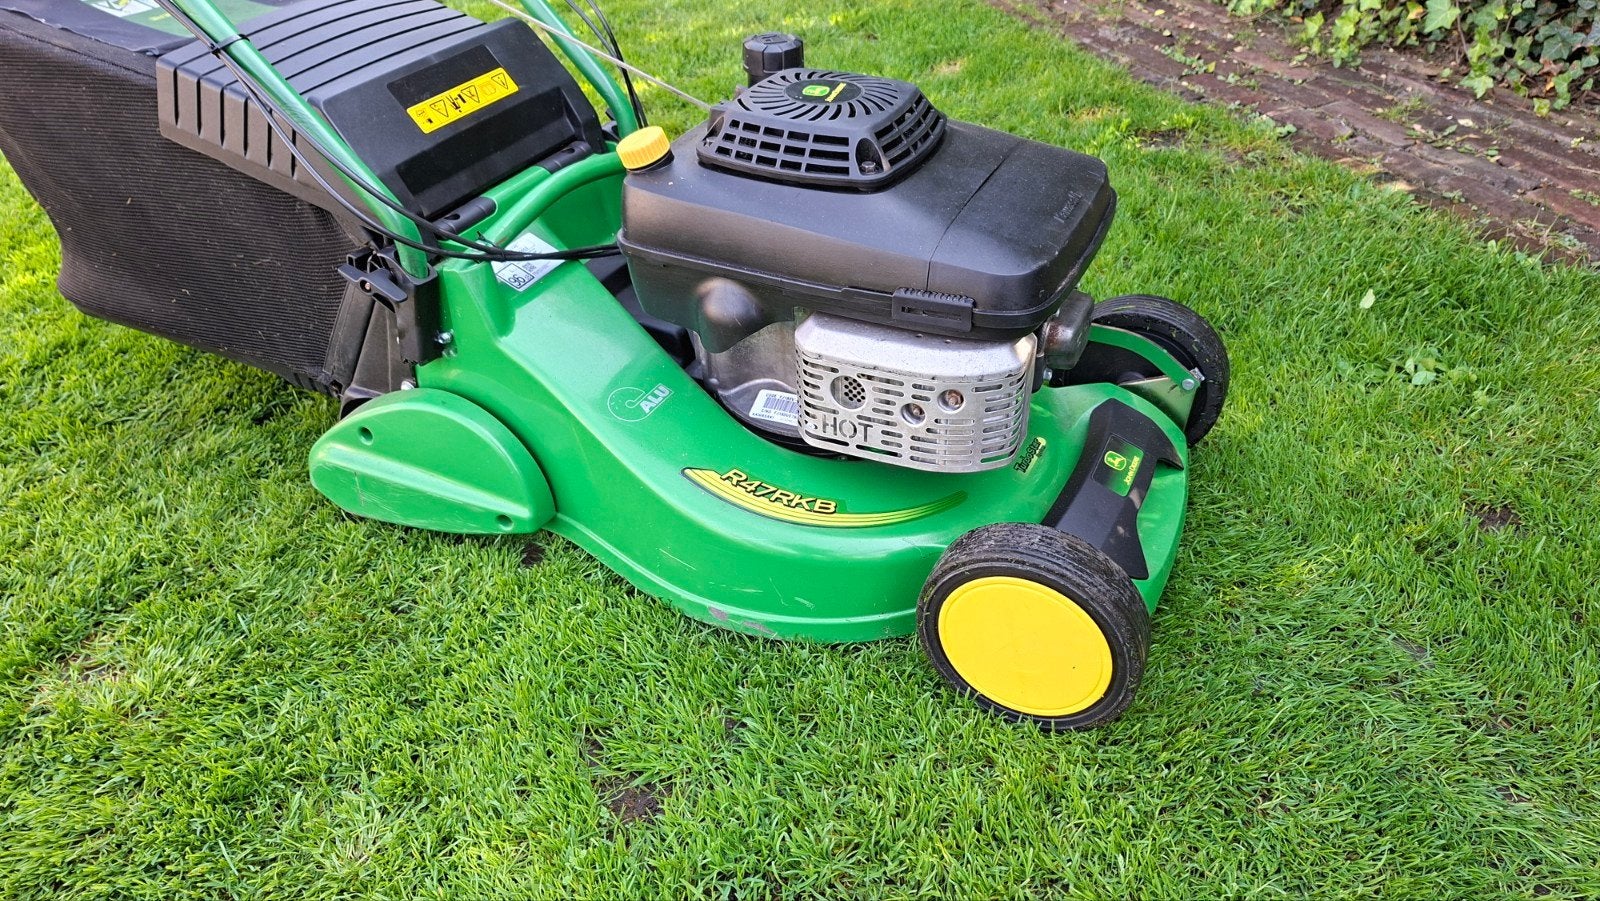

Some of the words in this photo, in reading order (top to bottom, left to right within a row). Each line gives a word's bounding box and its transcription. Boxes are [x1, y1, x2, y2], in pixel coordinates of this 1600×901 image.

[508, 273, 526, 286] 96
[639, 385, 671, 414] ALU
[822, 414, 874, 442] HOT
[720, 469, 837, 514] R47RKB
